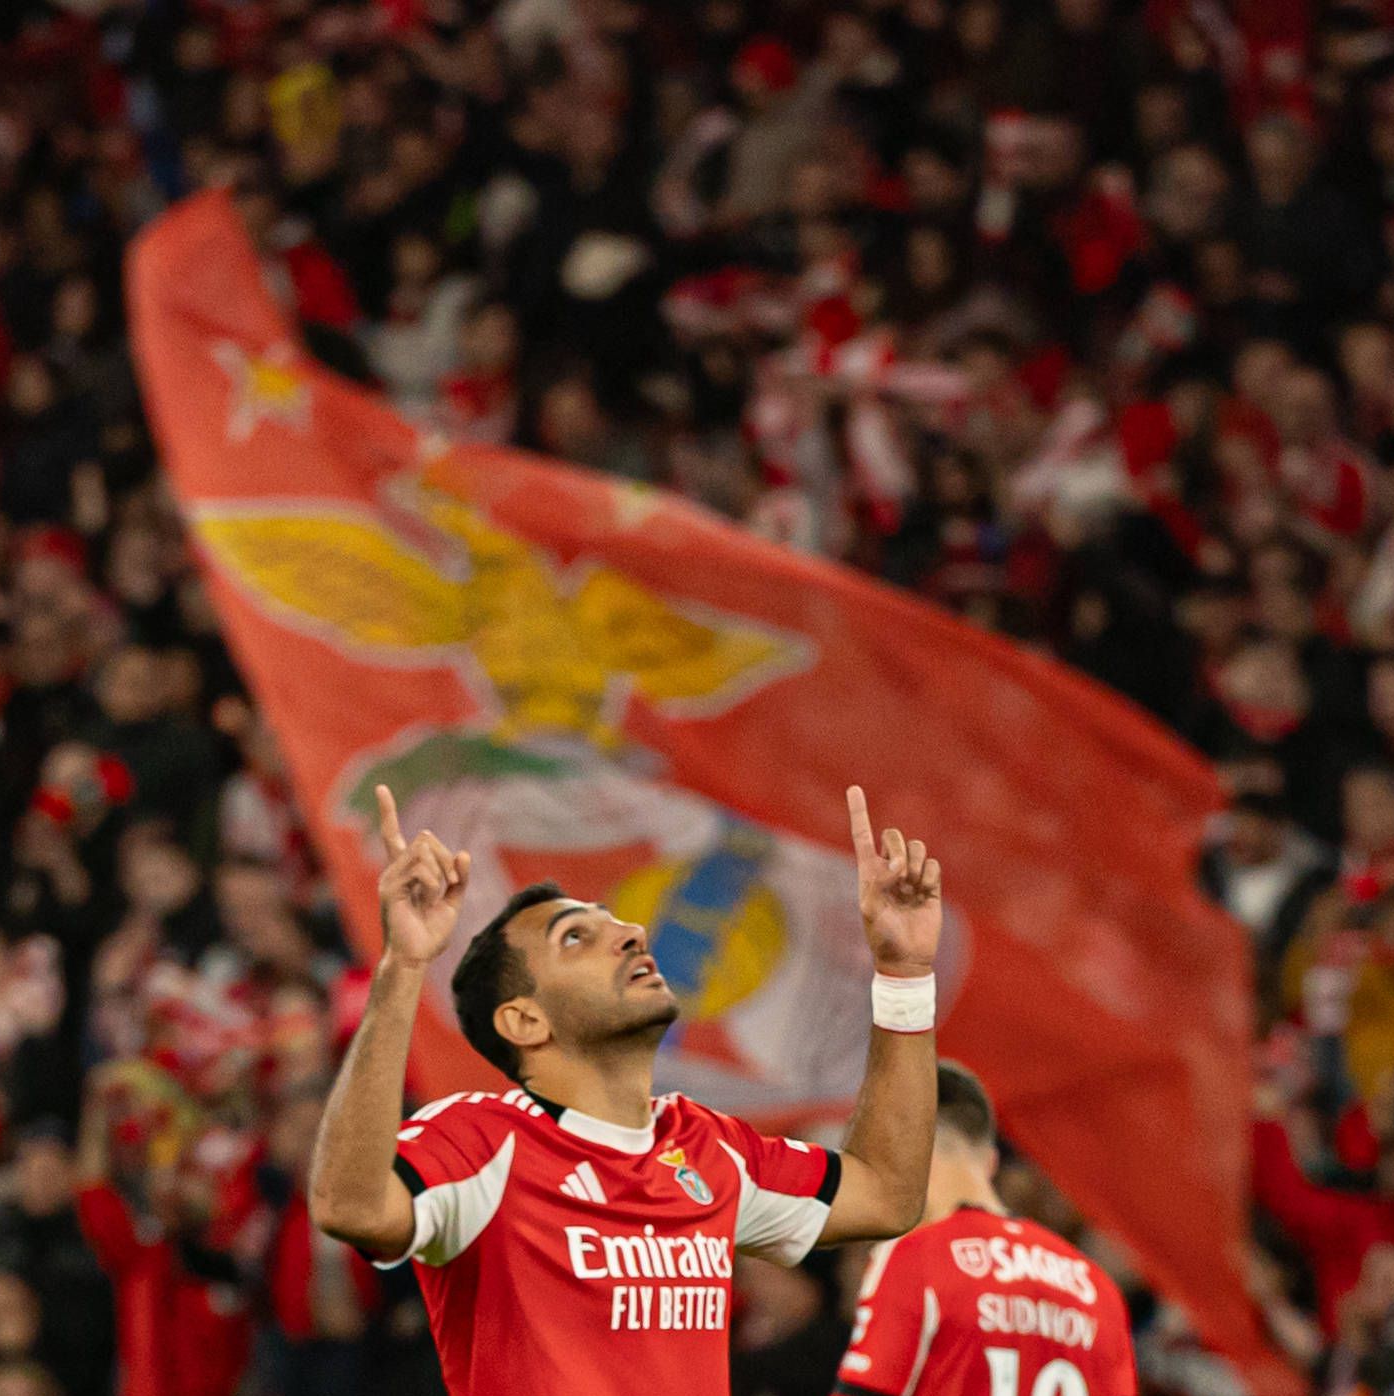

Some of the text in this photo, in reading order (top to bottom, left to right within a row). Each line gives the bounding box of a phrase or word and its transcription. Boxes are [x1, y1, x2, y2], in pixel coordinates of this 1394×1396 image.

[565, 1223, 732, 1279] Emirates
[610, 1286, 726, 1330] FLY BETTER
